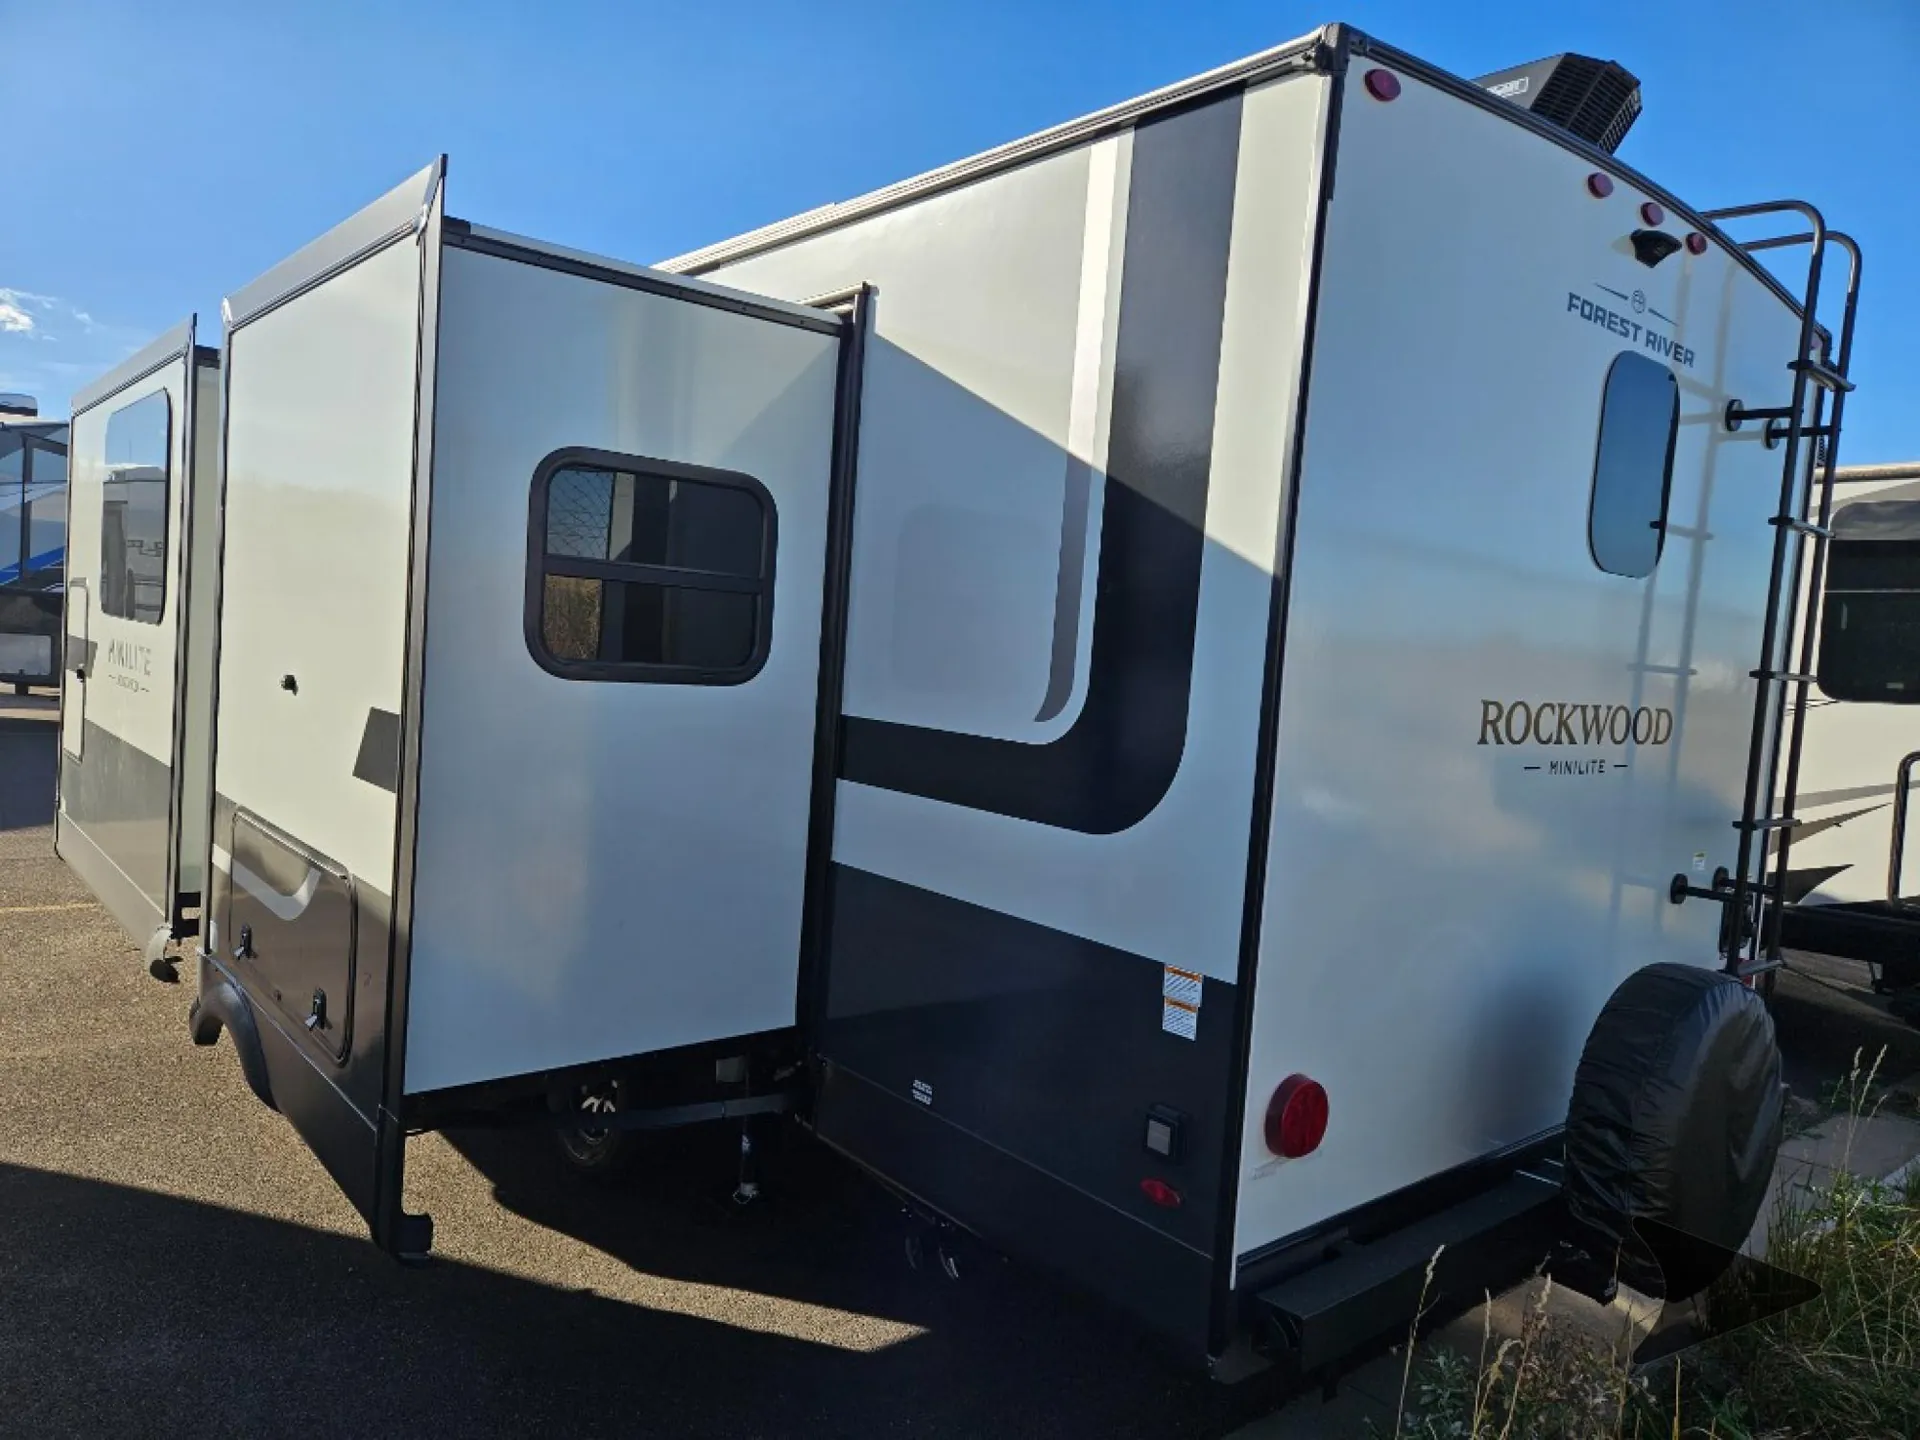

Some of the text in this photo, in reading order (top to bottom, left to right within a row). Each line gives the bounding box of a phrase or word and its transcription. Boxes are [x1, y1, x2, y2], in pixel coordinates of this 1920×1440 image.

[1567, 291, 1696, 368] FOREST RIVER
[1477, 699, 1673, 746] ROCKWOOD
